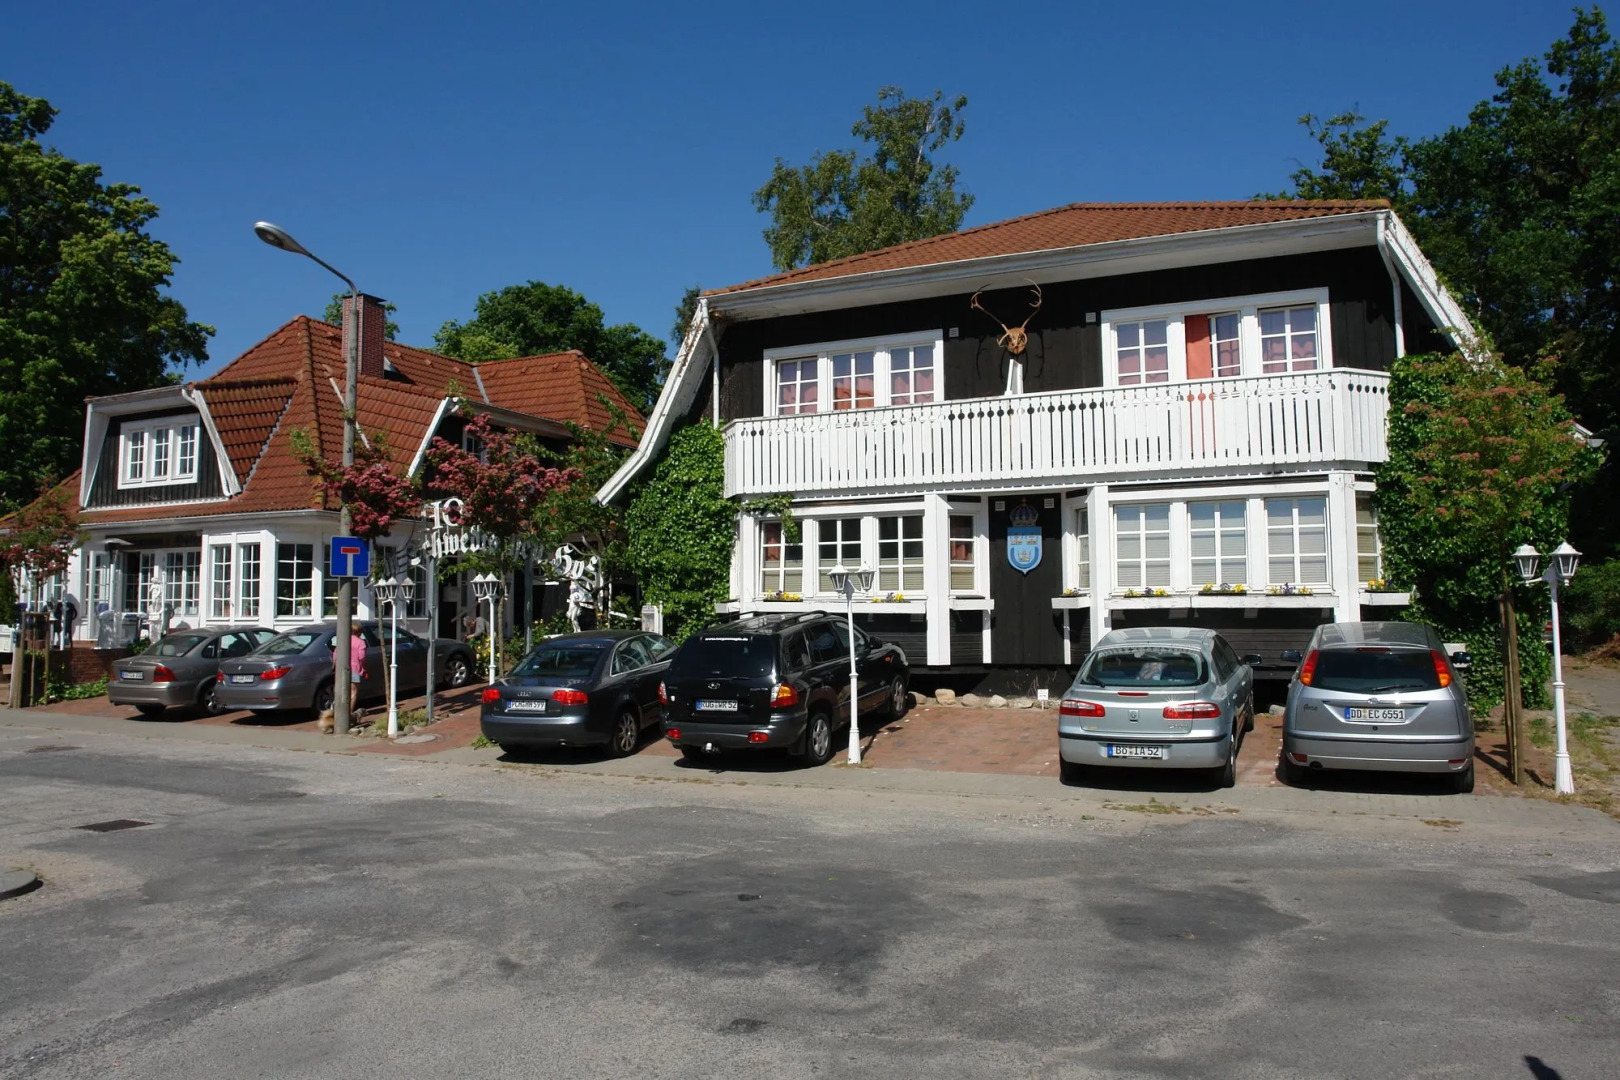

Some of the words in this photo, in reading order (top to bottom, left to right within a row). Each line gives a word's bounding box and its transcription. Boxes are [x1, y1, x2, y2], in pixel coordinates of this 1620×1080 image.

[1350, 709, 1362, 719] DD
[1368, 709, 1380, 719] EC
[1382, 709, 1405, 720] 6551
[1134, 746, 1146, 755] IA
[1147, 746, 1159, 756] 52
